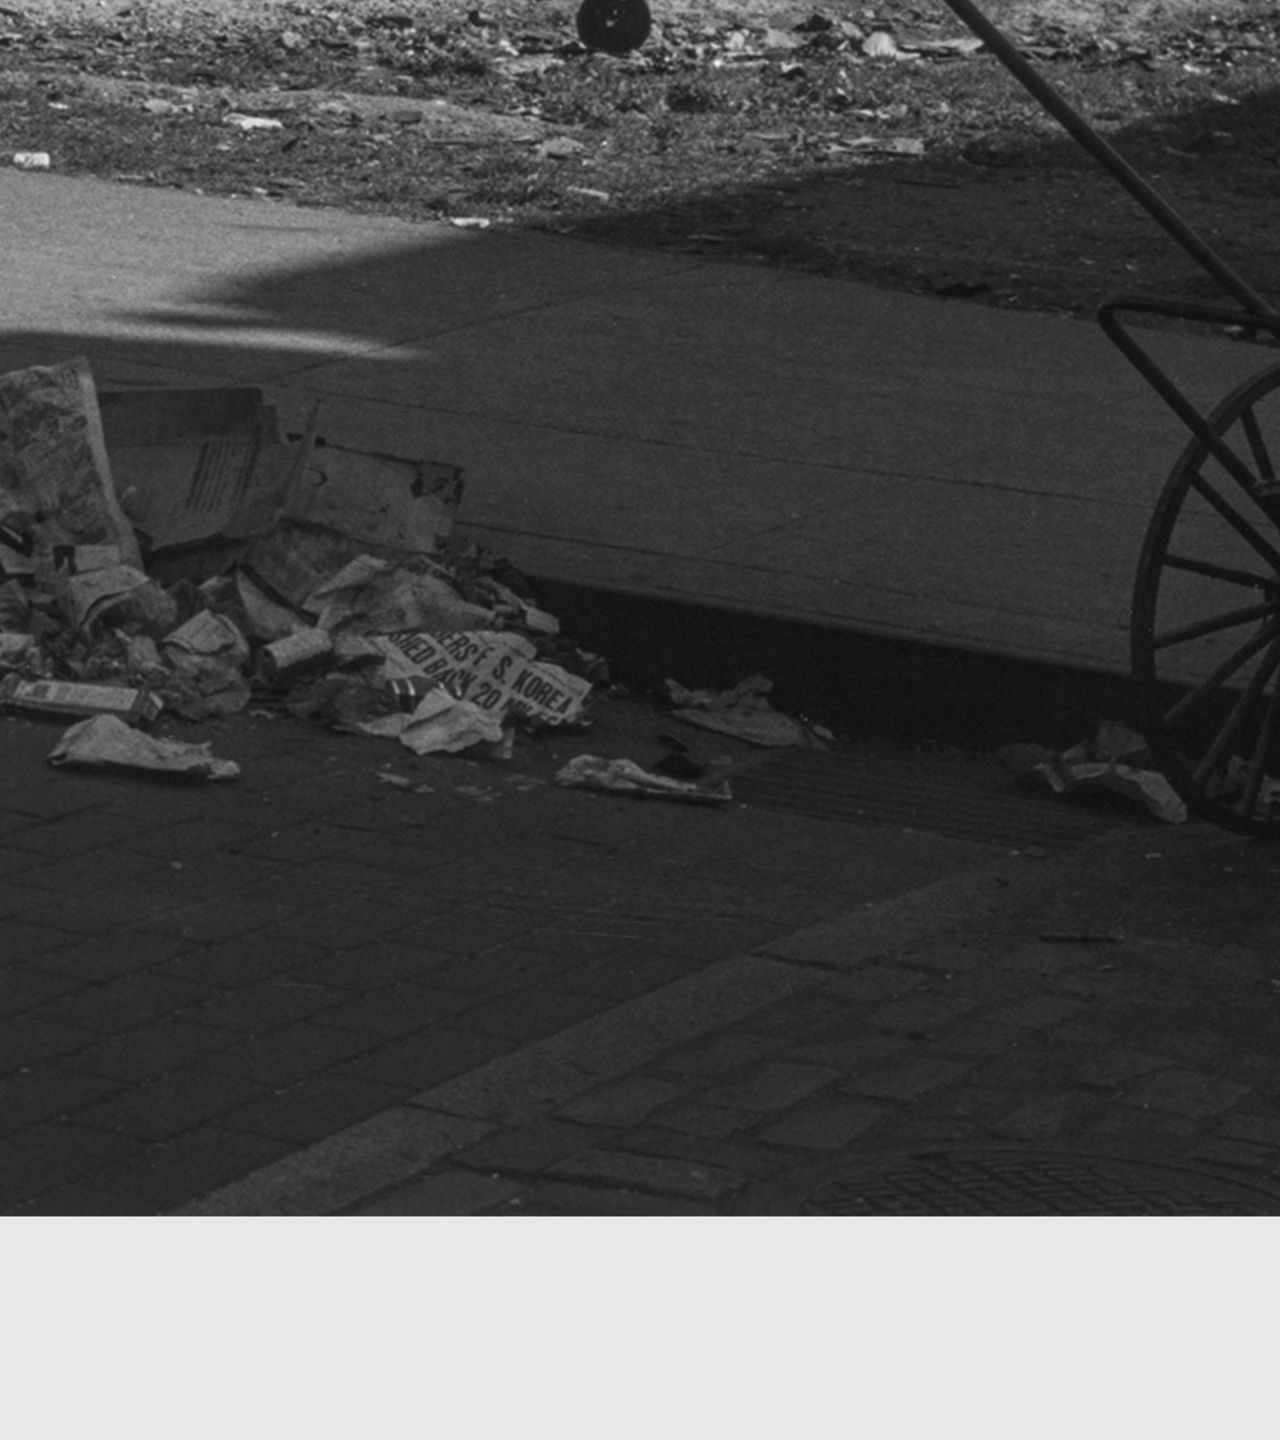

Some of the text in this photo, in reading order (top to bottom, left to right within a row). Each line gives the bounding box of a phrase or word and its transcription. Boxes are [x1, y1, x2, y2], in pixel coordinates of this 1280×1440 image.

[470, 681, 503, 711] 20
[491, 655, 513, 686] S.
[511, 667, 574, 715] KOREA
